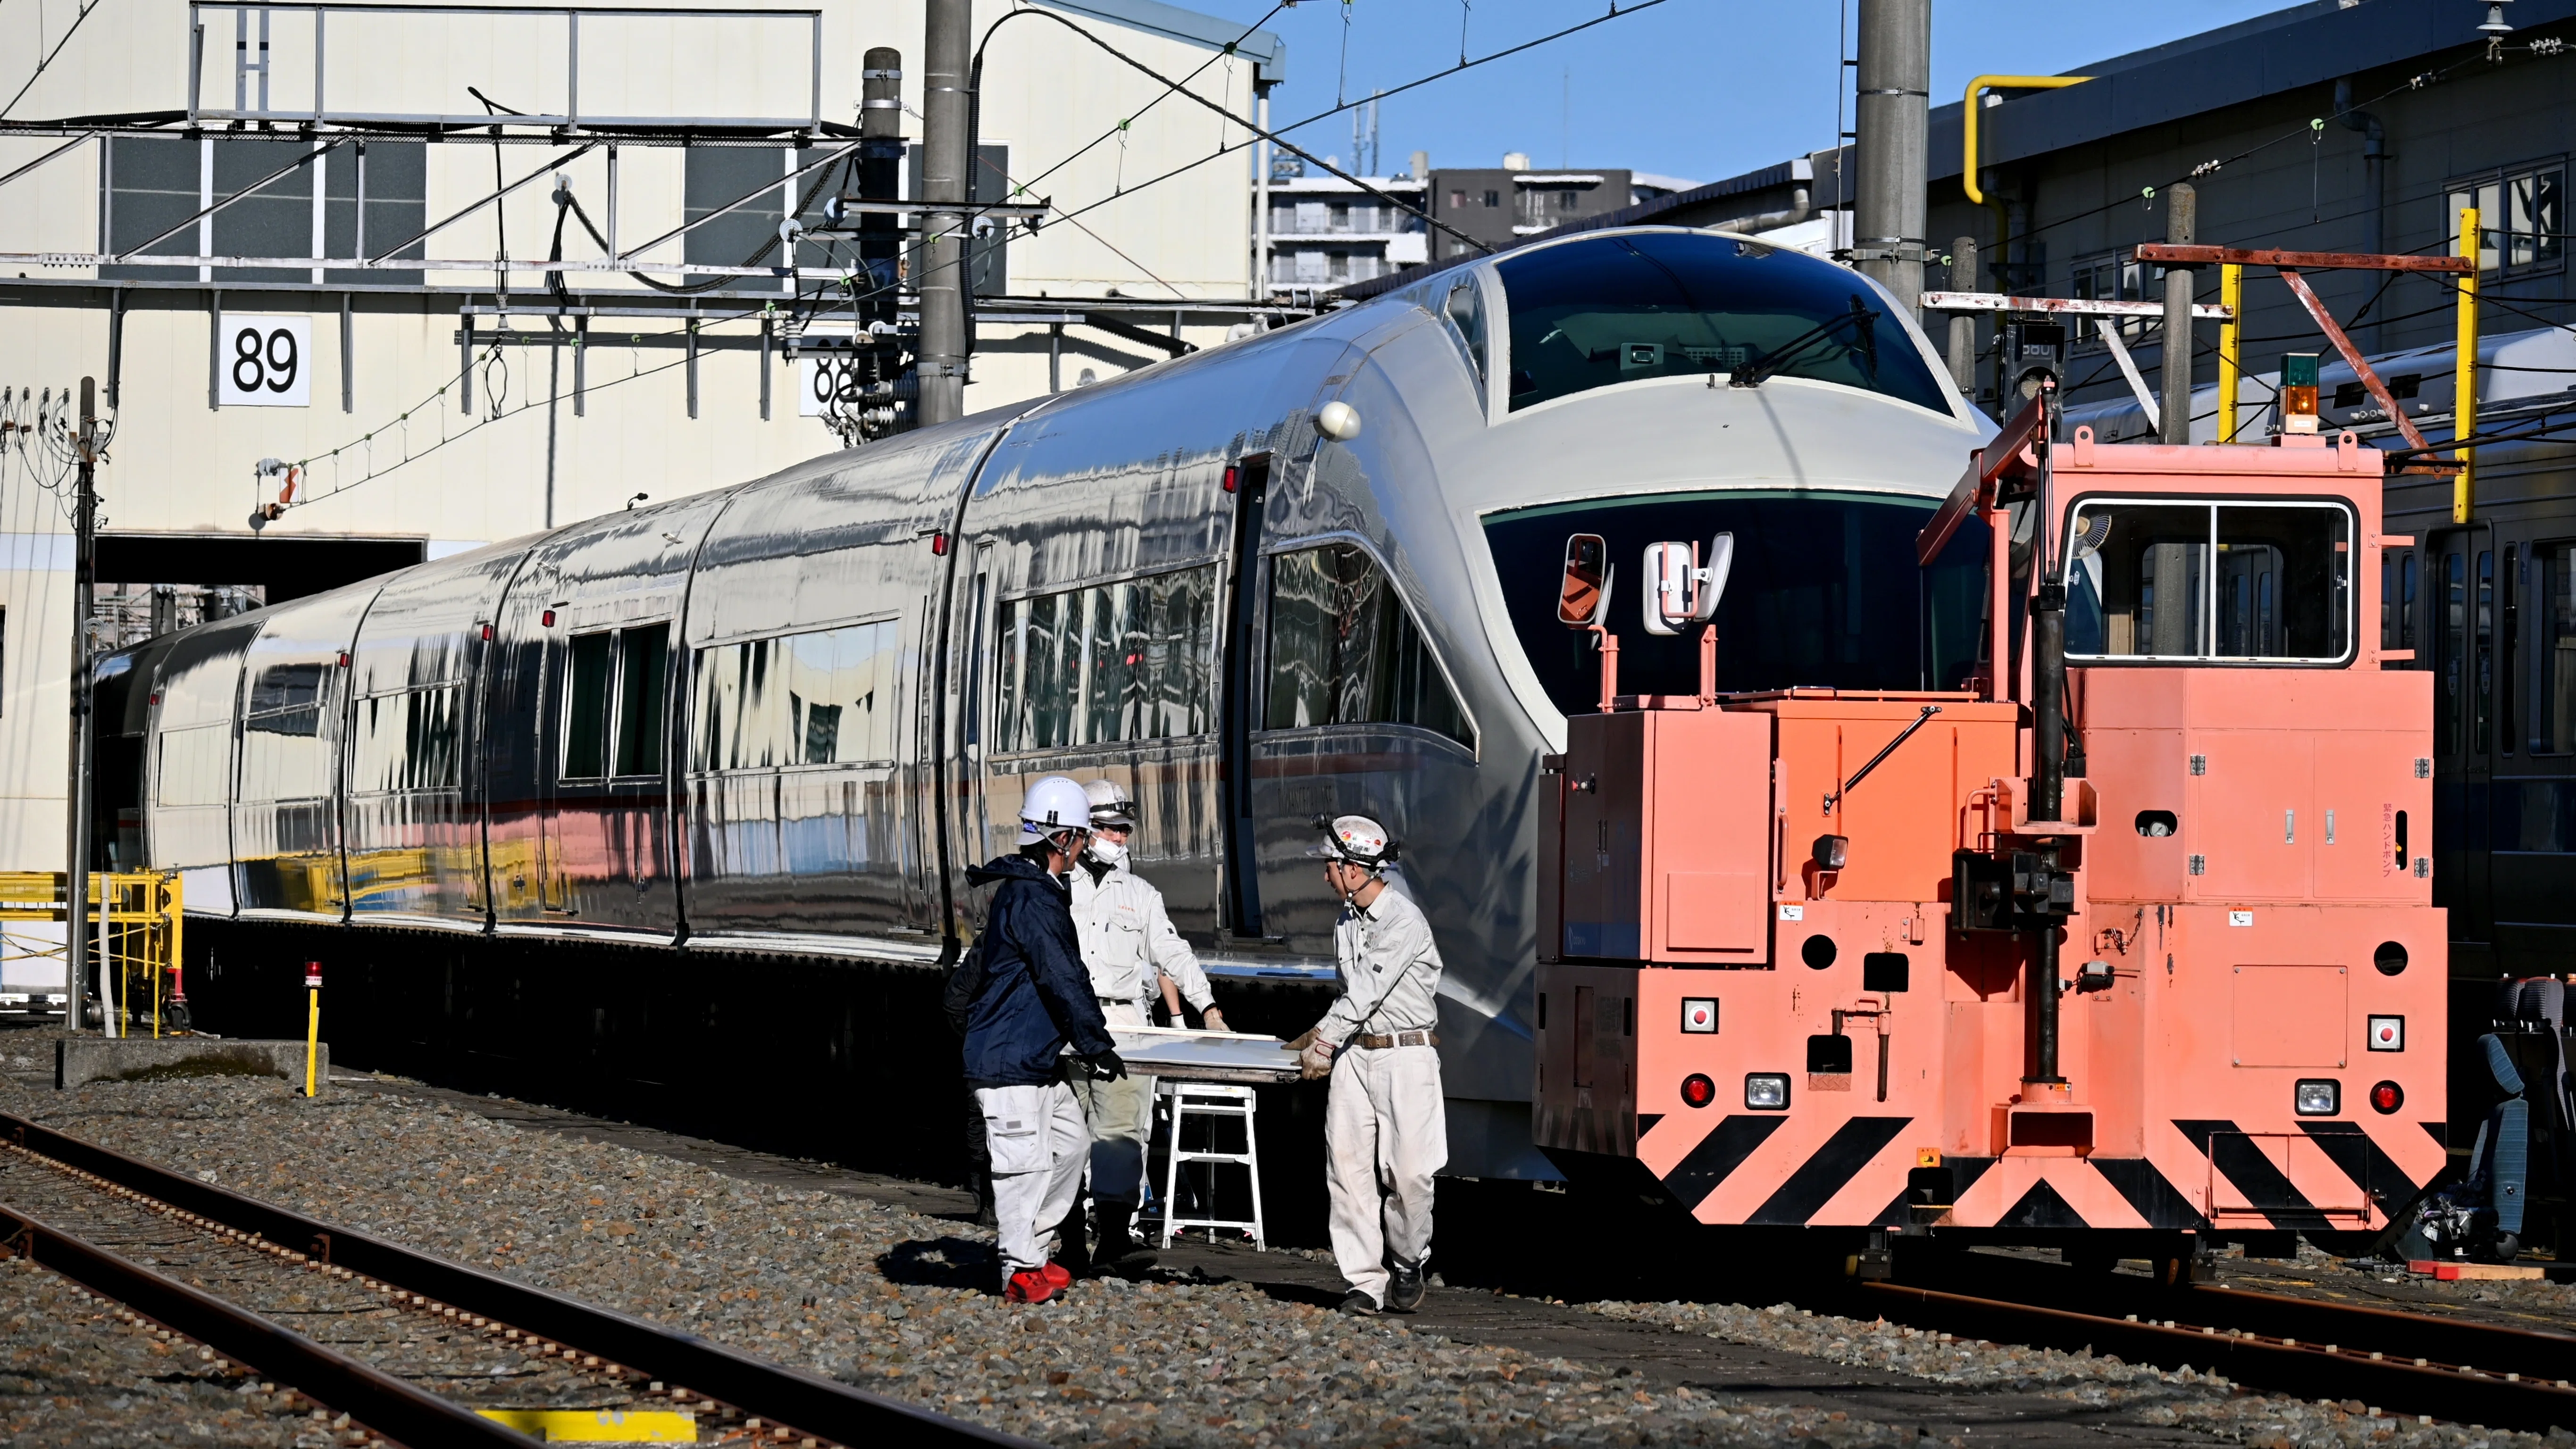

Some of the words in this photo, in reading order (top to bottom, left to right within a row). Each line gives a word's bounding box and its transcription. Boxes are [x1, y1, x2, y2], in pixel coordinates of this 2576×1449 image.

[233, 327, 297, 393] 89
[2383, 803, 2392, 878] 緊急ハンドポンプ
